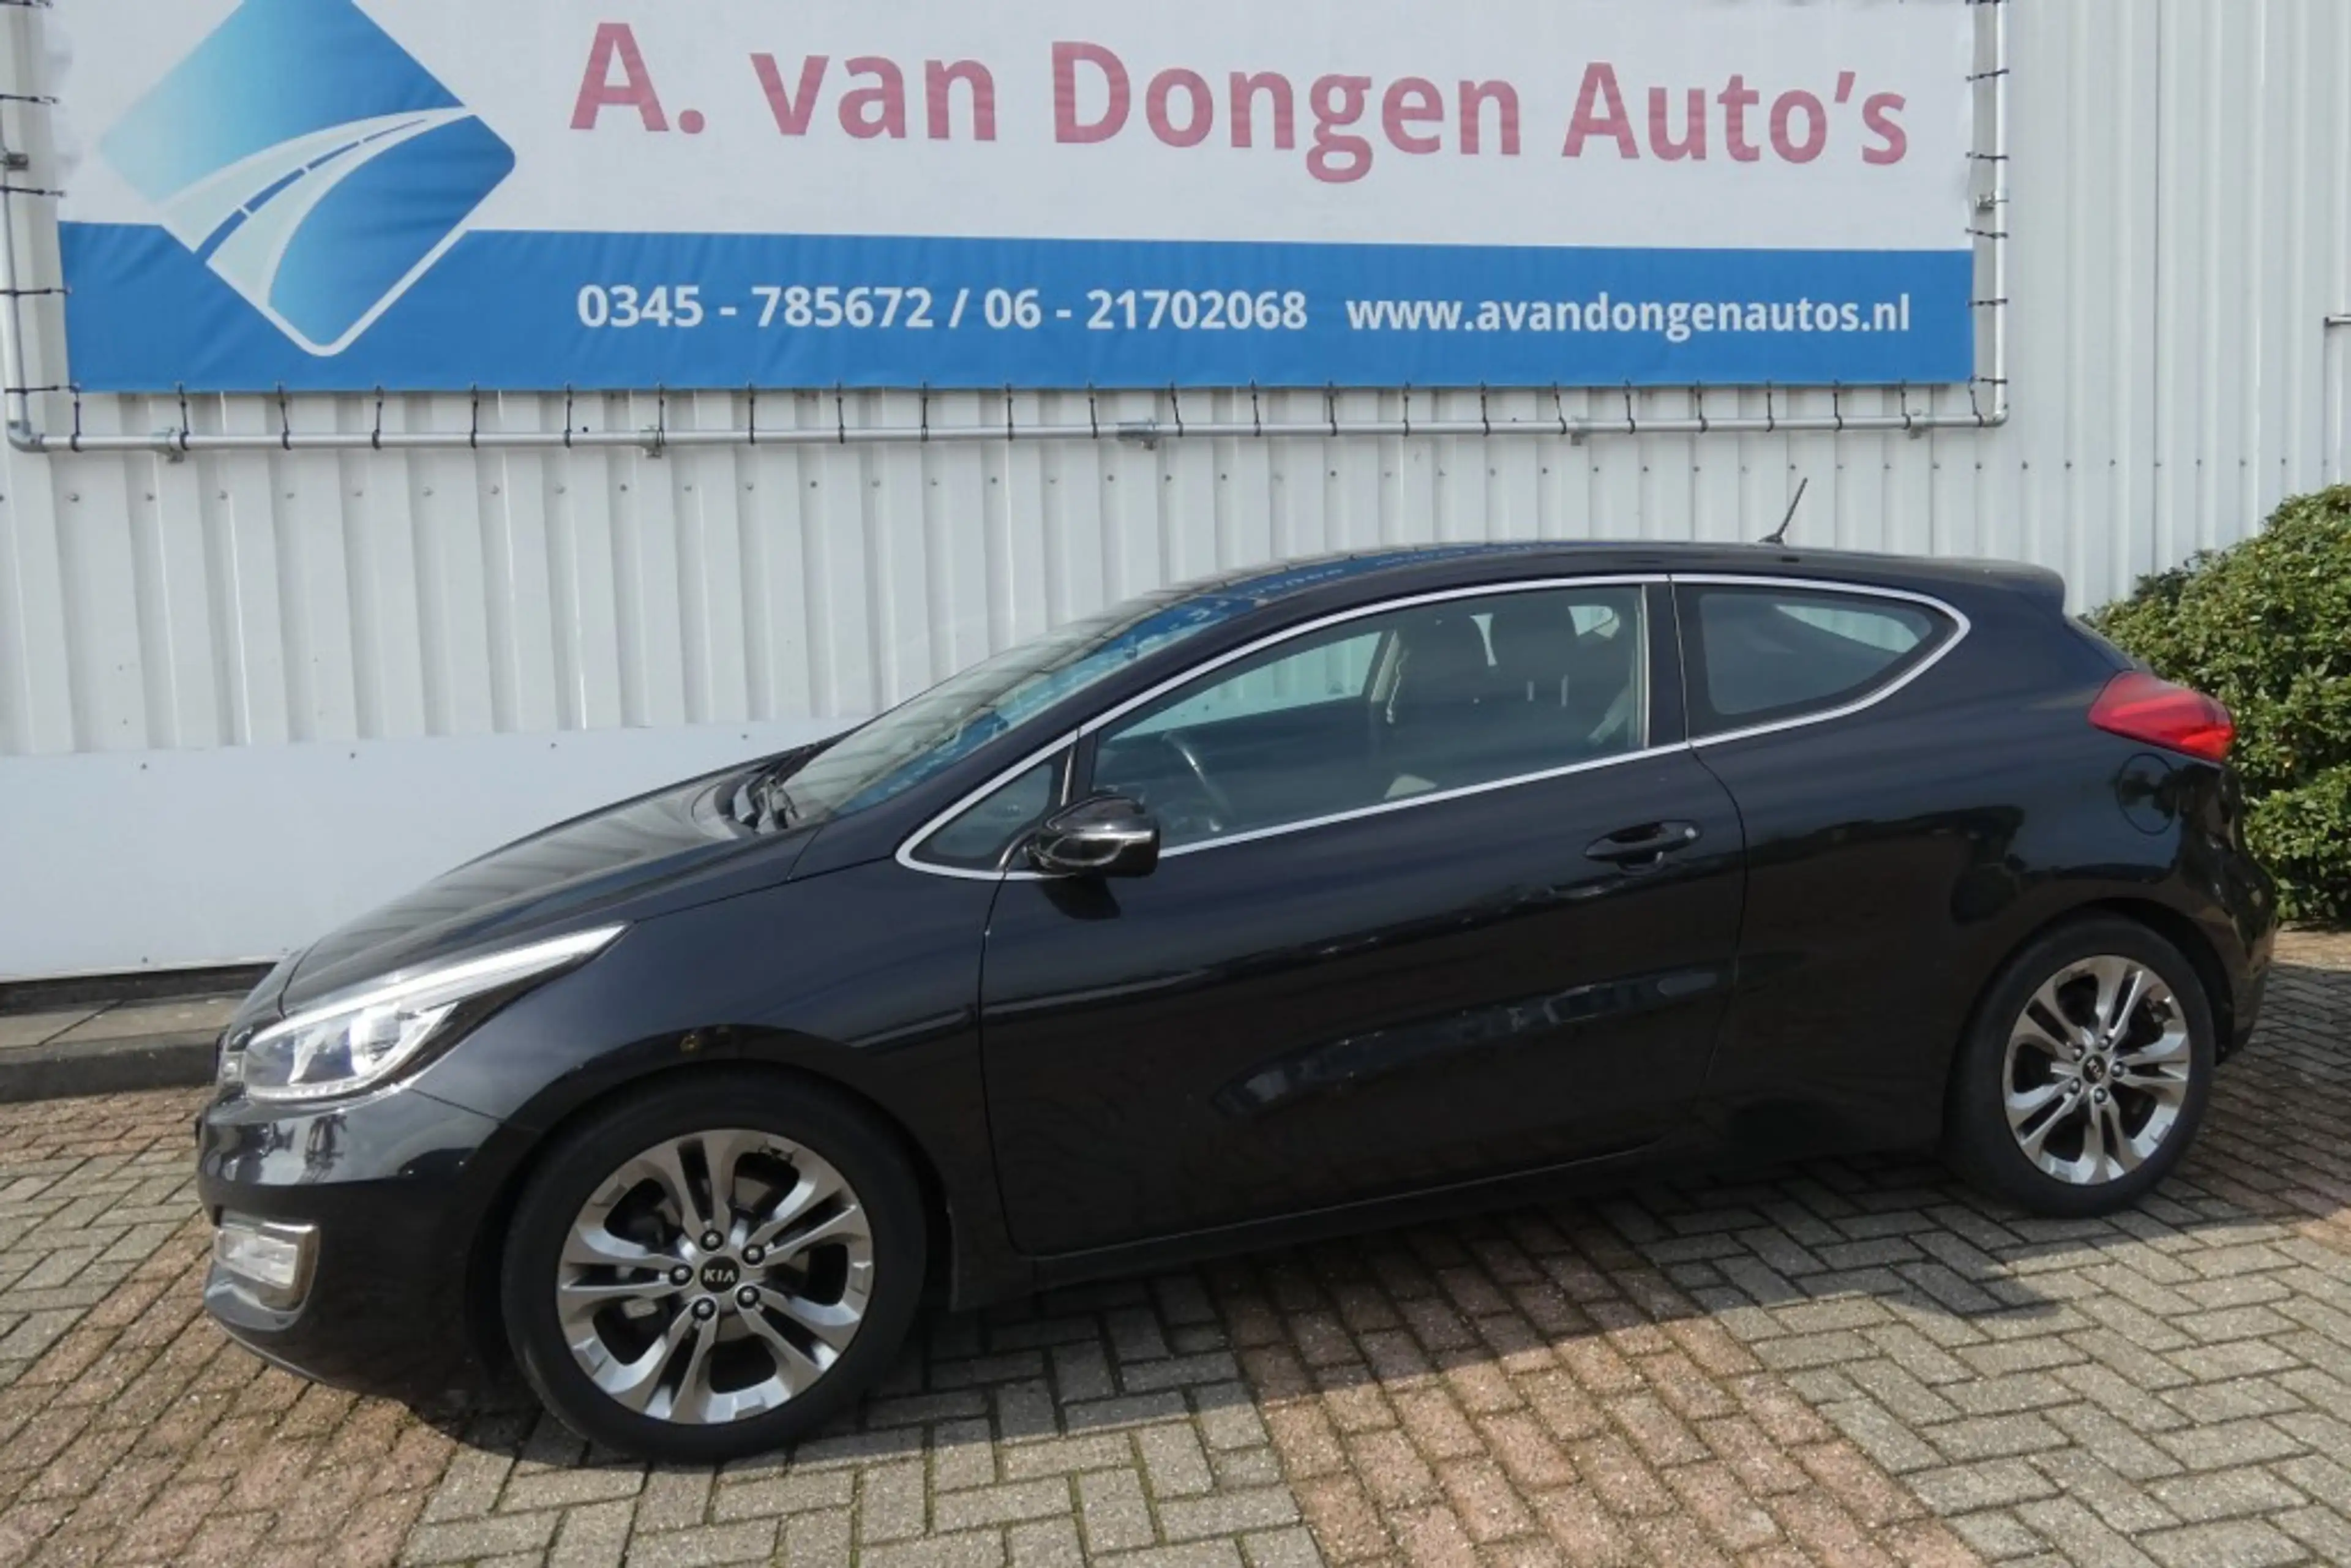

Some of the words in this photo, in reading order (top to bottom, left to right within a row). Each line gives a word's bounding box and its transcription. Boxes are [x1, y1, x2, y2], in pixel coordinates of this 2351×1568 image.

[570, 22, 706, 135] A.
[749, 53, 997, 141] van
[1051, 41, 1521, 184] Dongen
[577, 284, 704, 328] 0345
[719, 306, 737, 316] -
[751, 285, 934, 328] 785672
[949, 288, 970, 329] /
[984, 288, 1041, 329] 06
[1056, 309, 1072, 318] -
[1087, 289, 1308, 330] 21702068
[1345, 292, 1910, 343] www.avandongenautos.nl
[703, 1269, 735, 1283] KIA
